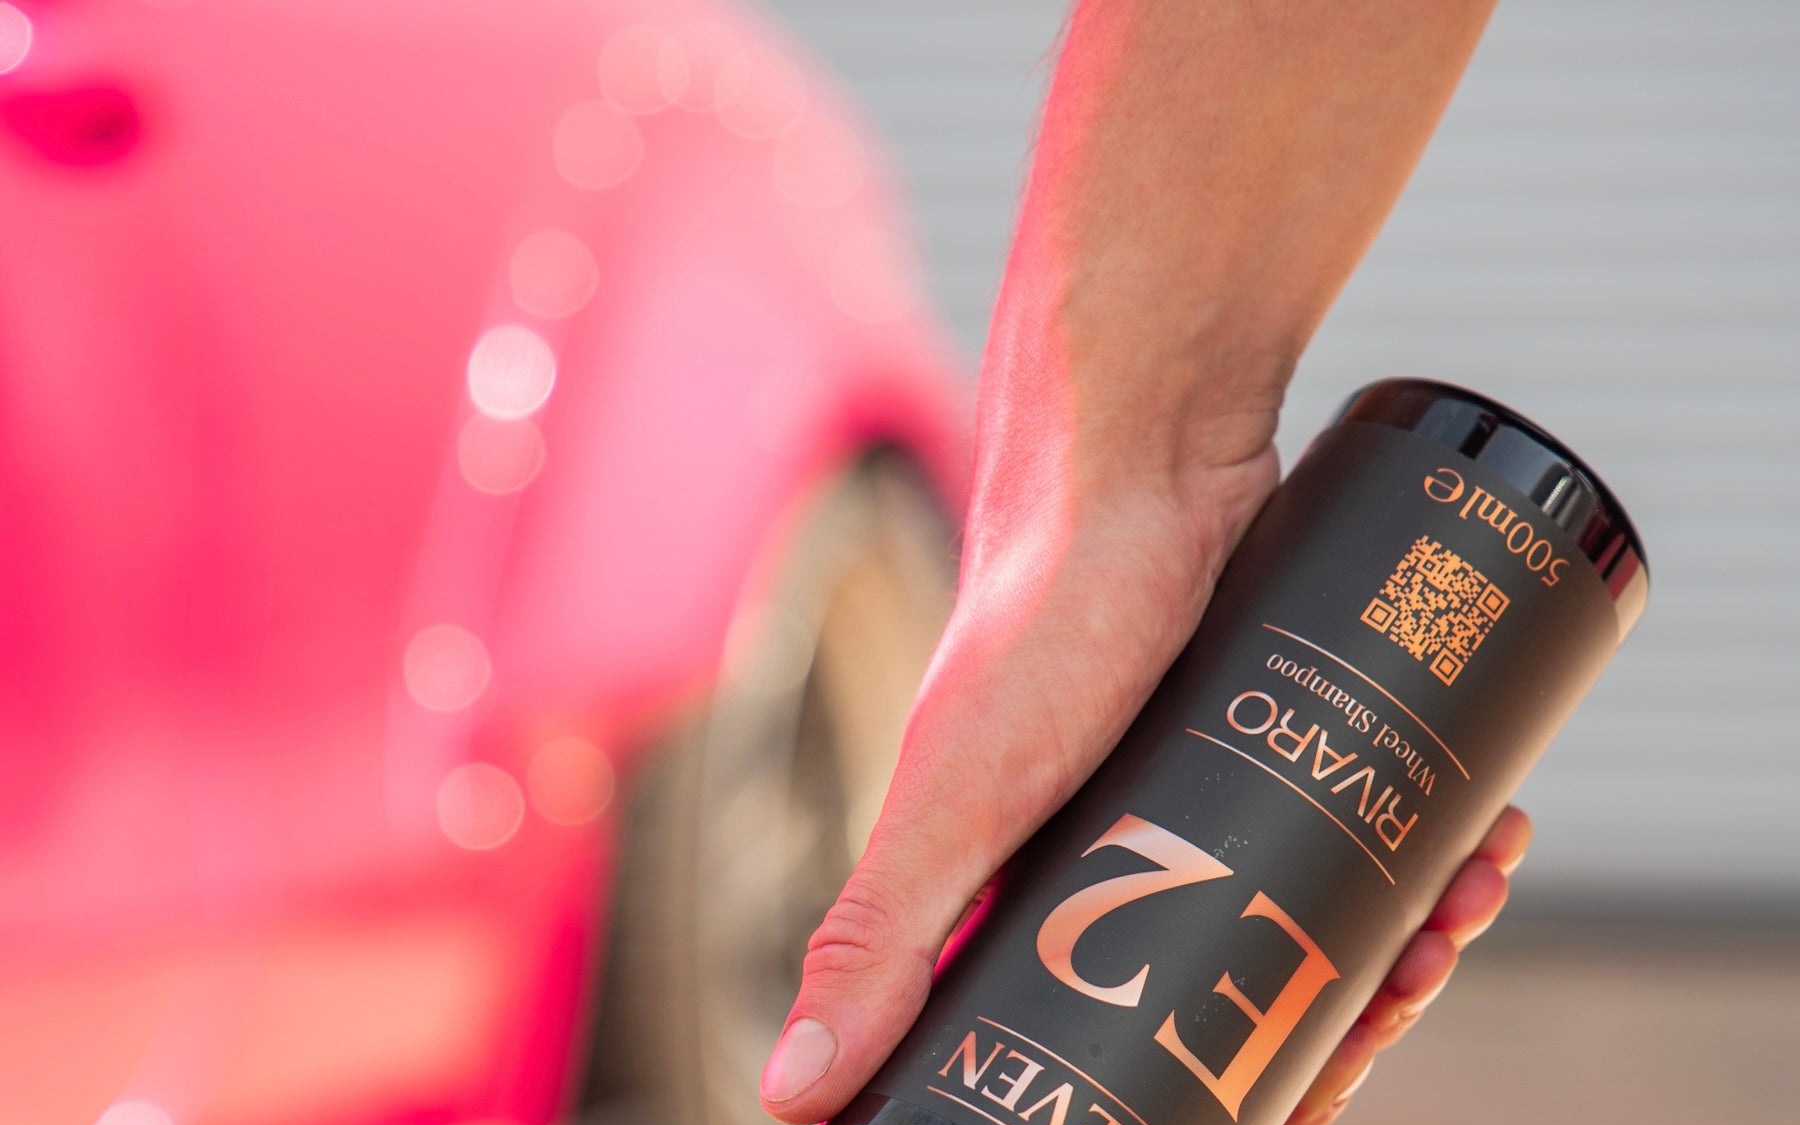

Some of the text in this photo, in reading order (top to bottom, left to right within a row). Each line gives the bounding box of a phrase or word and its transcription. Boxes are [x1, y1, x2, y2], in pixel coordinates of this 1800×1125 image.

[1226, 690, 1418, 851] RIVARO
[1266, 653, 1437, 796] Wheel Shampoo
[1036, 812, 1341, 1123] E2
